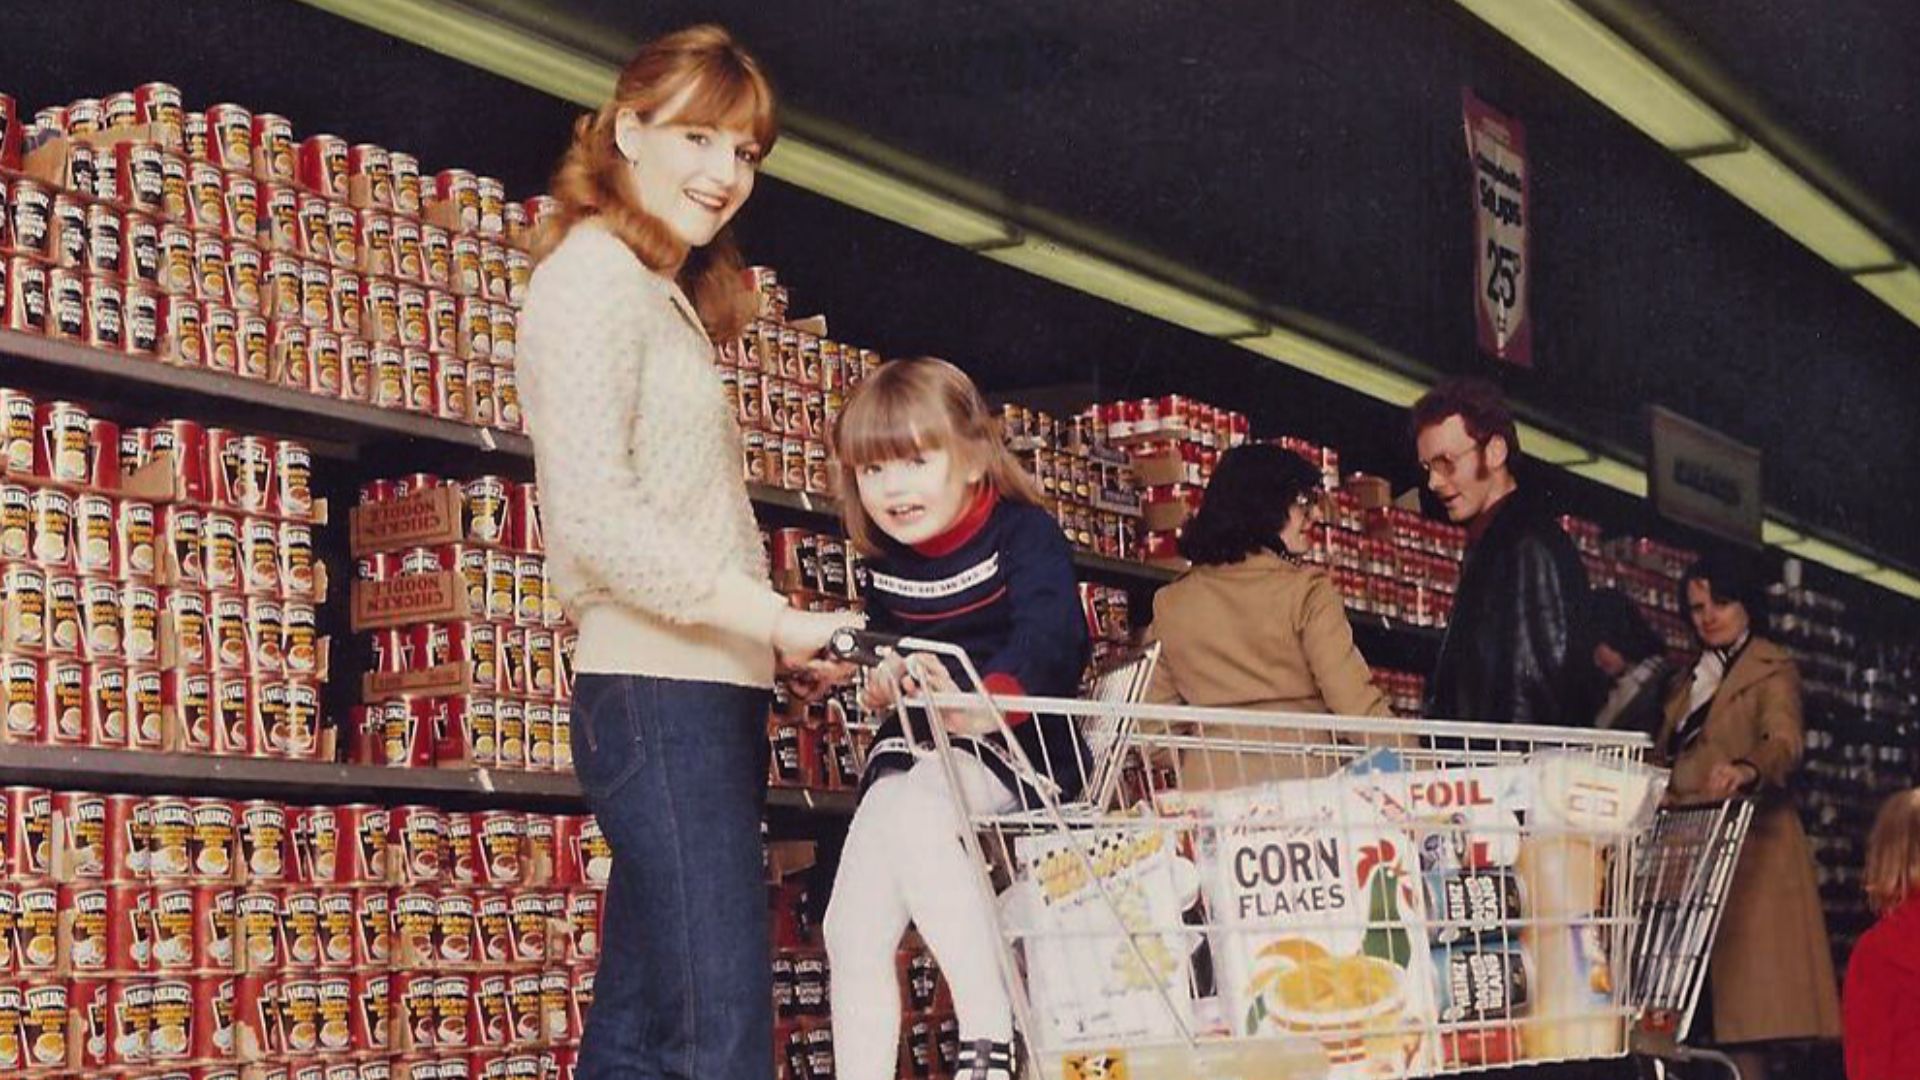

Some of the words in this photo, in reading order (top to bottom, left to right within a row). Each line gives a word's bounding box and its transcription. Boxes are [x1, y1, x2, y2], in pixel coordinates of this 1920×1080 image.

[1410, 780, 1494, 808] FOIL
[1235, 837, 1340, 889] CORN
[1239, 884, 1346, 920] FLAKES
